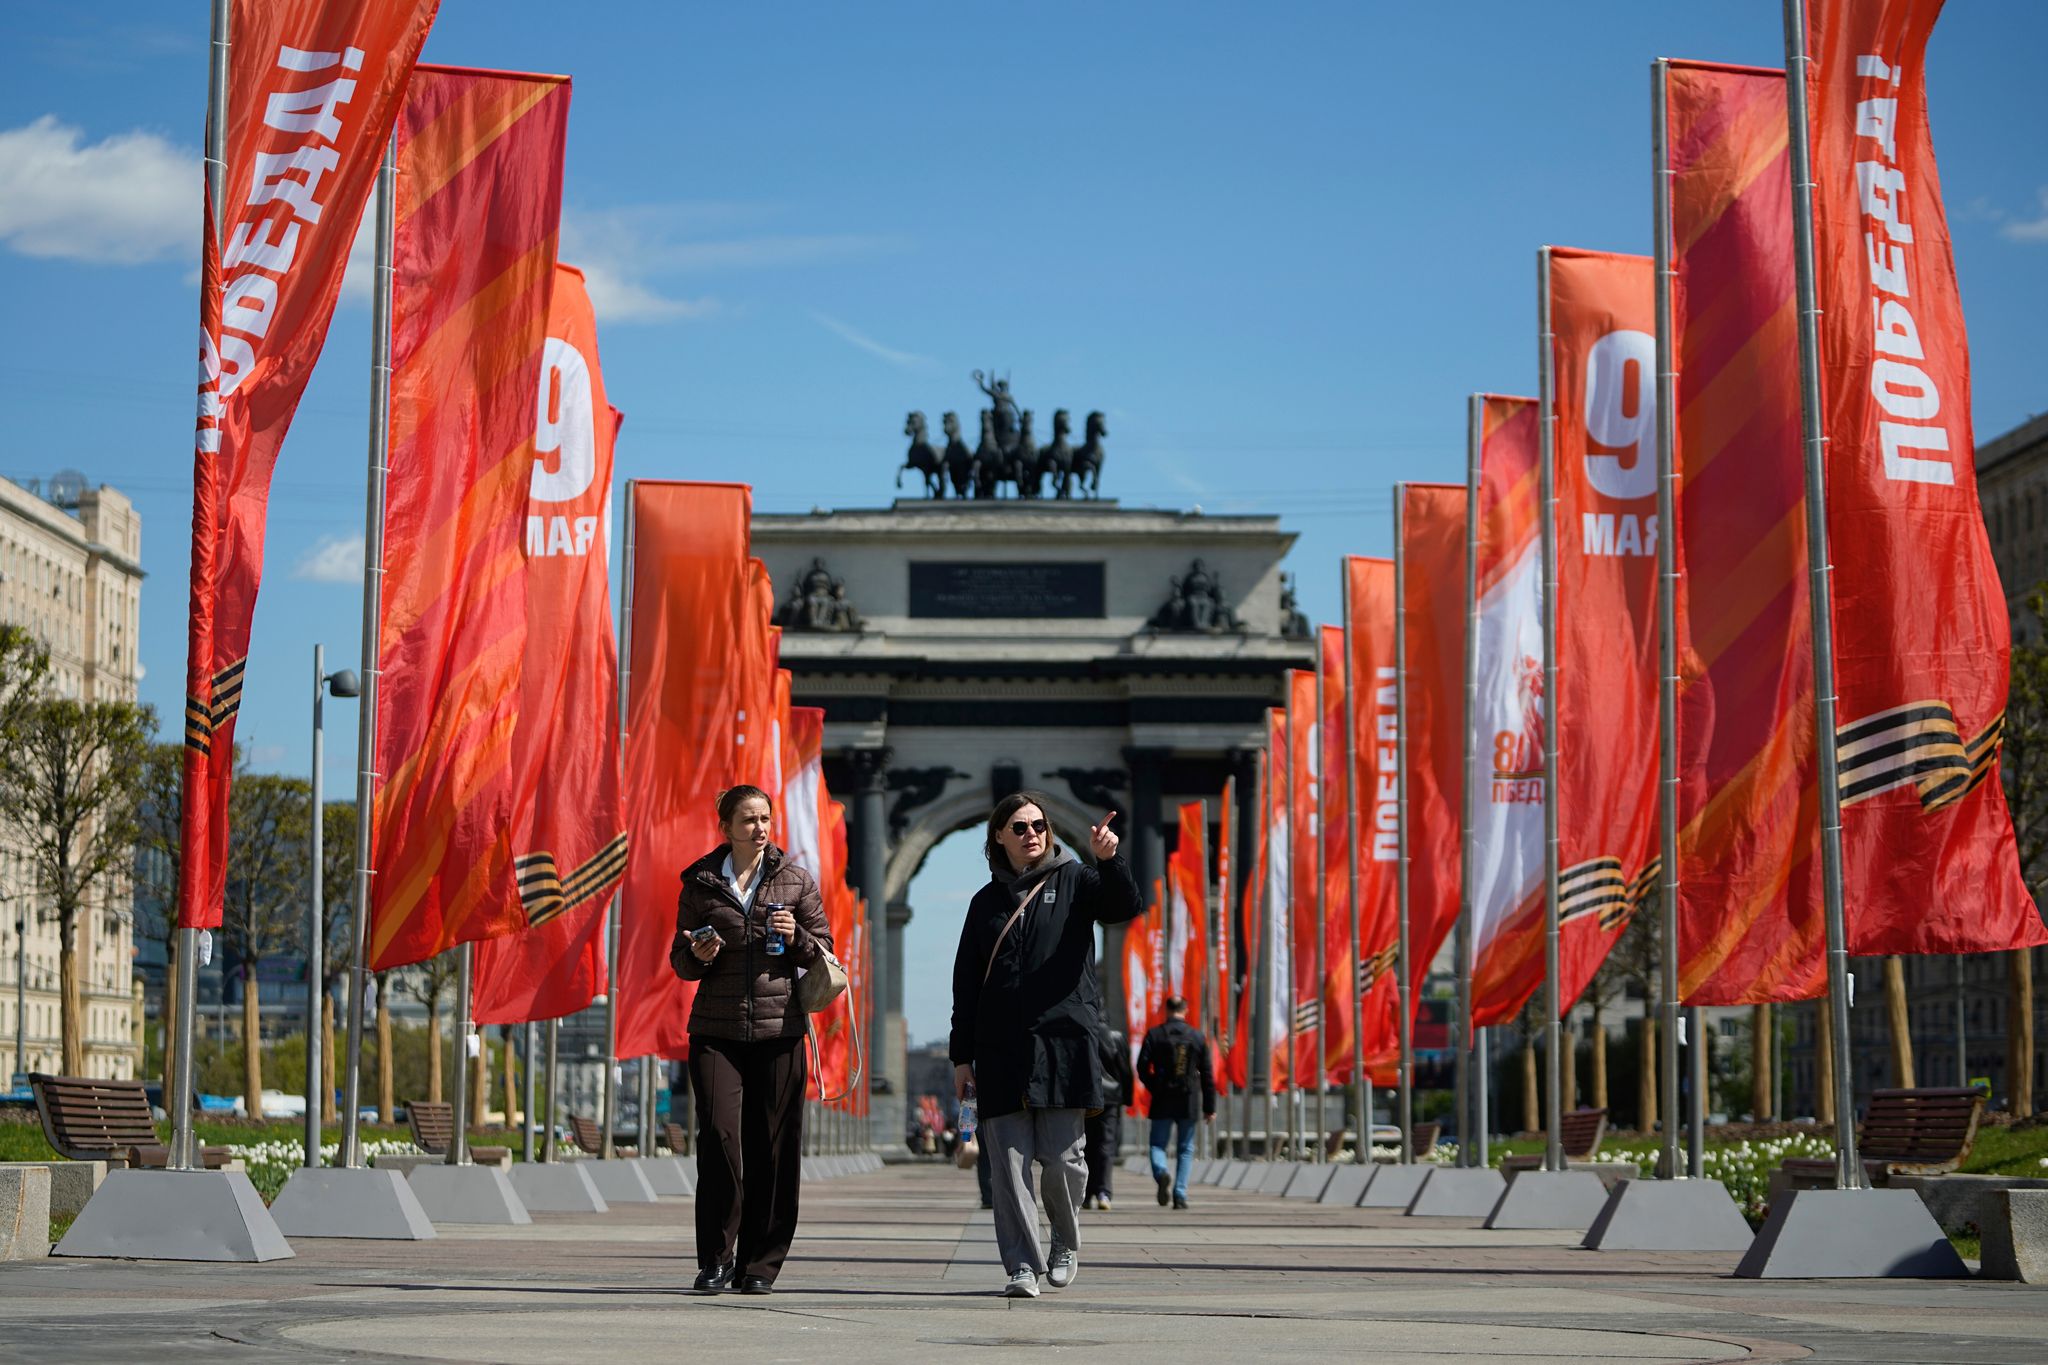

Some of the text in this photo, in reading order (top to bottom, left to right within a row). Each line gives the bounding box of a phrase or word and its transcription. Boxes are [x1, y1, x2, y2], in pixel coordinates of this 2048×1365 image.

[195, 45, 366, 455] ПОБЕДА!
[1856, 54, 1955, 486] ПОБЕДА!
[529, 336, 595, 502] 9
[1584, 329, 1658, 499] 9
